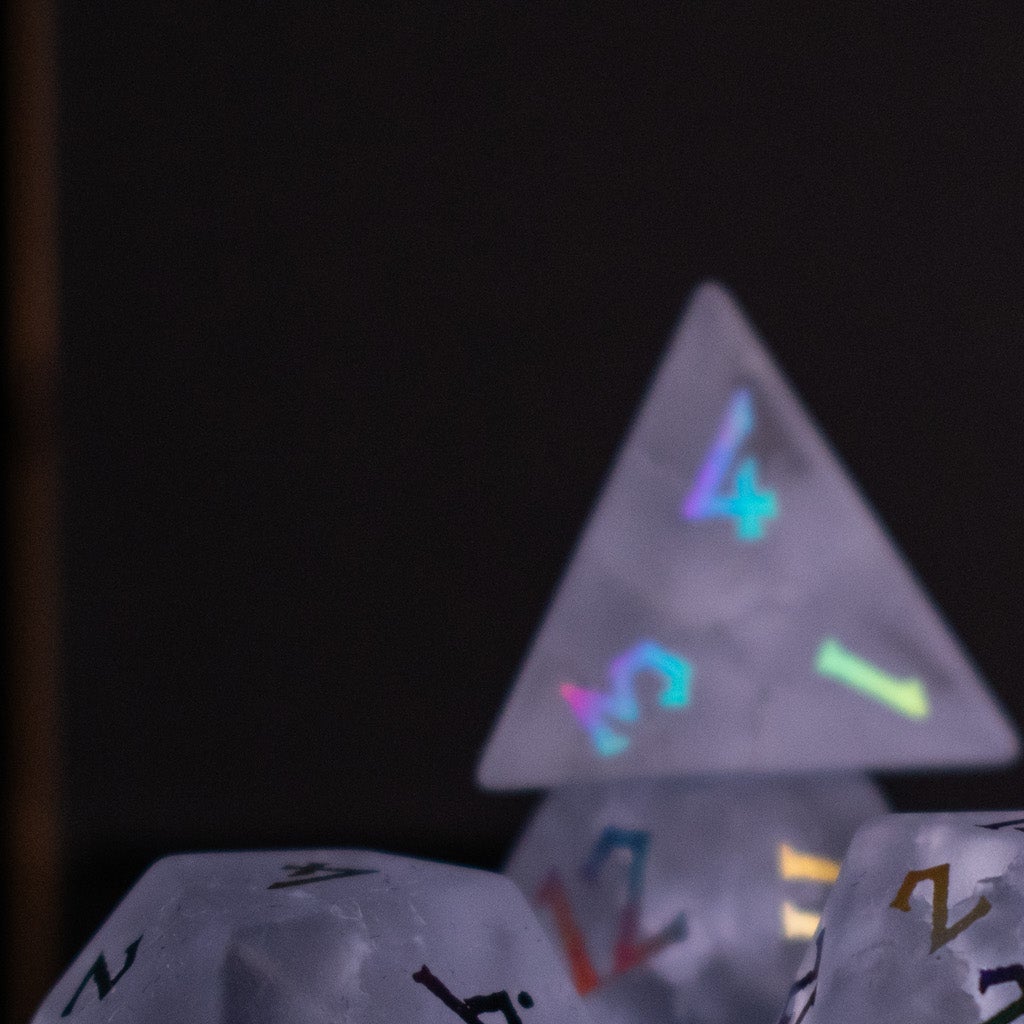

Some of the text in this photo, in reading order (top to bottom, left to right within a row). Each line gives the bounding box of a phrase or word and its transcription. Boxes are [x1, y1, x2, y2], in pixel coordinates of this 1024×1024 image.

[681, 386, 778, 542] 4
[560, 640, 695, 758] 3
[813, 633, 932, 721] 1
[534, 825, 692, 999] 12
[889, 863, 993, 956] 2
[60, 934, 144, 1018] 2
